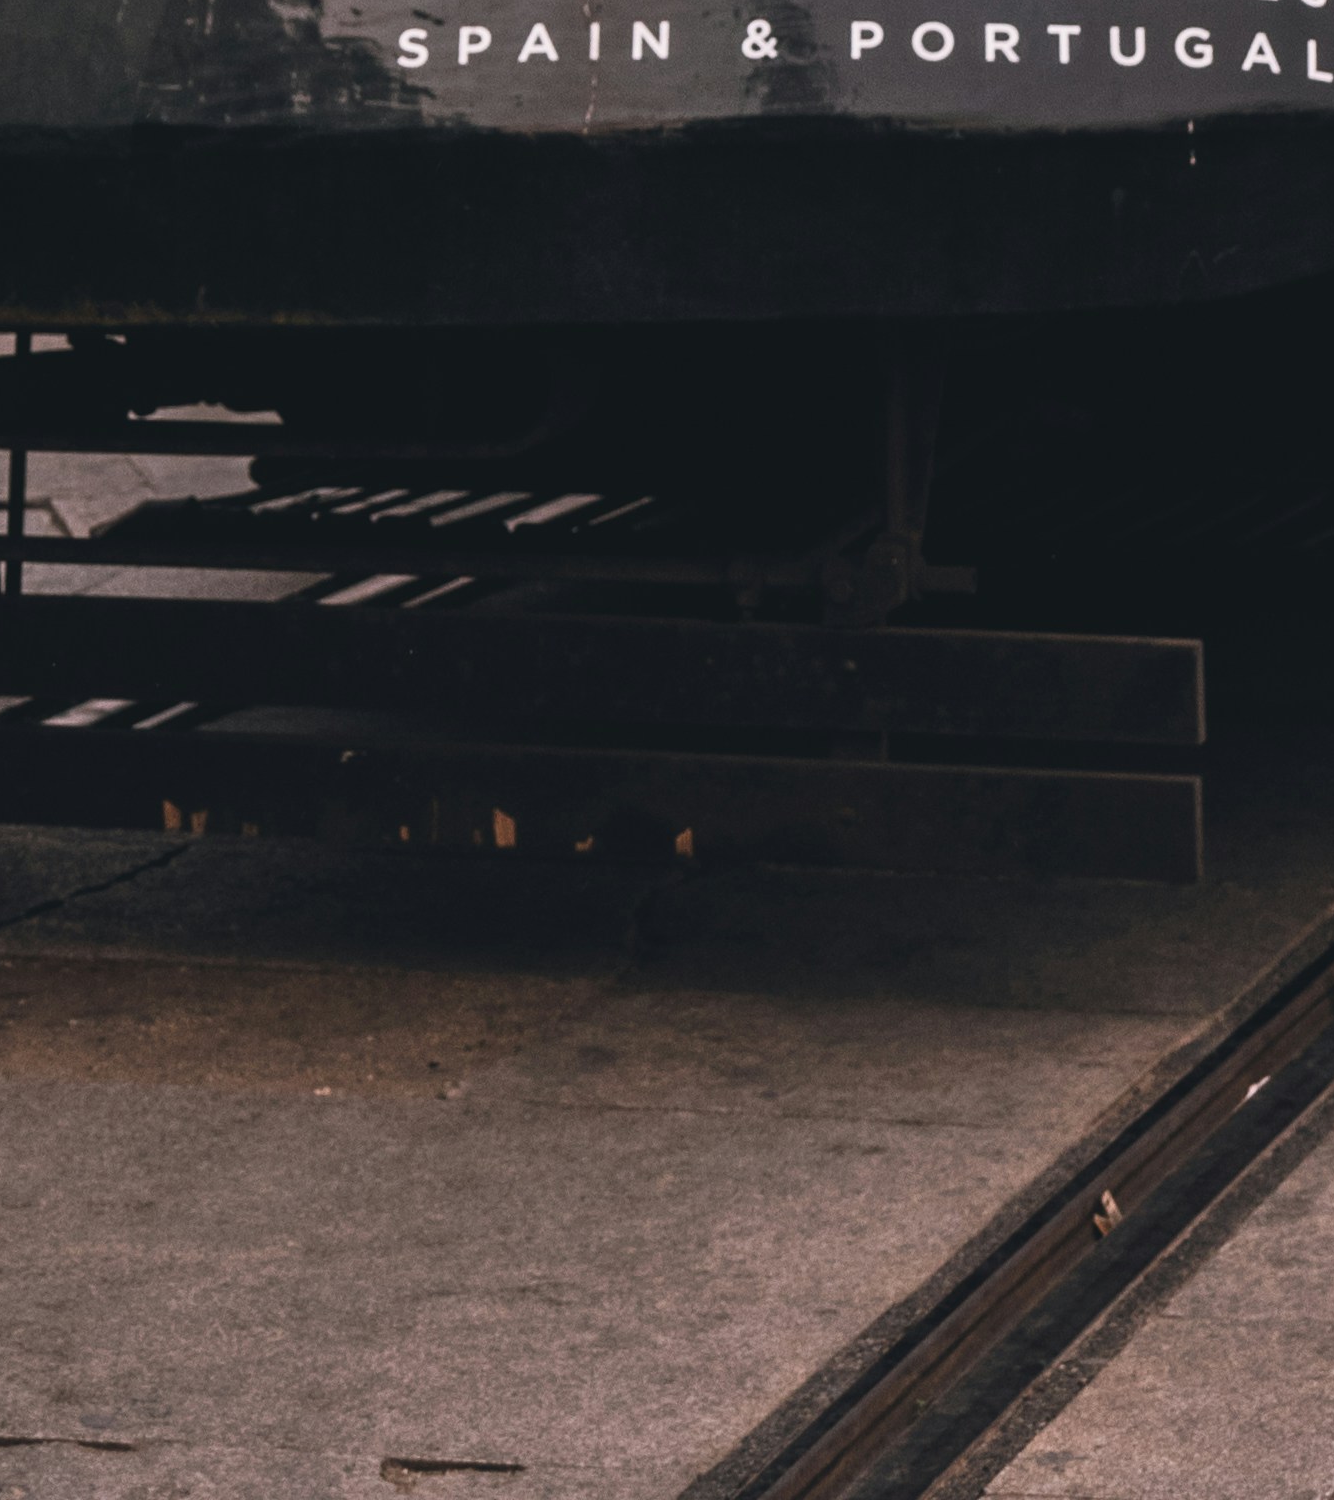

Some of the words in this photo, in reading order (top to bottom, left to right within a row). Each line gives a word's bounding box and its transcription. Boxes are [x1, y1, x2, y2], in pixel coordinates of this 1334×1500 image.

[396, 20, 670, 69] SPAIN
[740, 18, 778, 61] &
[850, 20, 1334, 83] PORTUGAL
